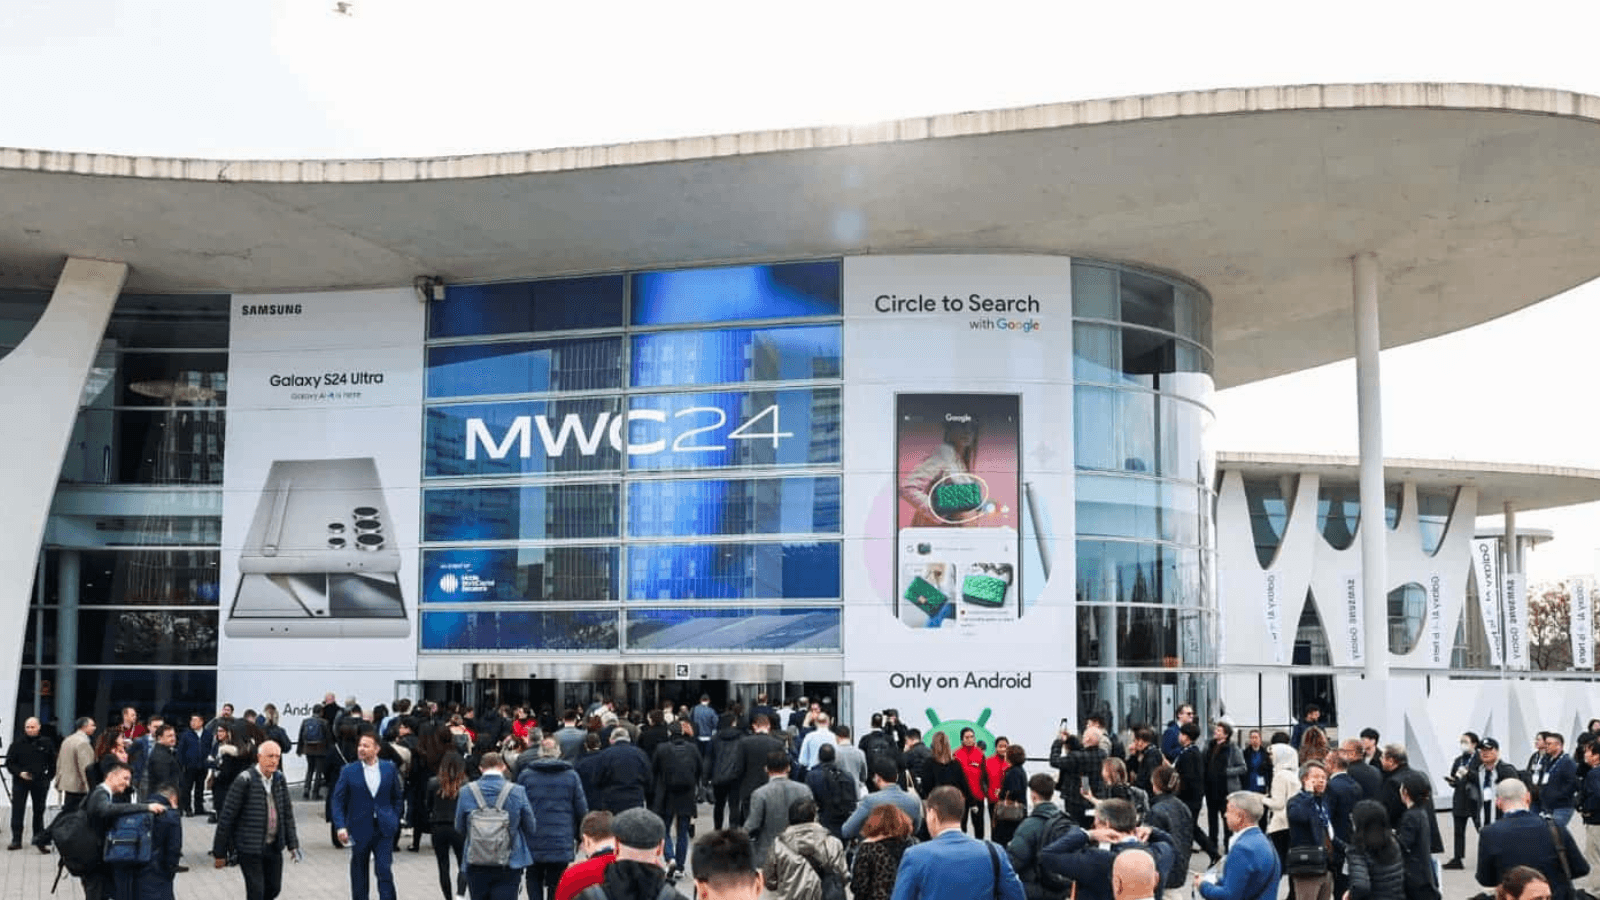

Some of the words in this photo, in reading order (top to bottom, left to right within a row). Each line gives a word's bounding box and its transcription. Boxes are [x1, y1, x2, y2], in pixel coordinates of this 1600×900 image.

[241, 304, 302, 315] SAMSUNG
[875, 294, 936, 313] Circle
[942, 295, 964, 312] to
[969, 294, 1040, 313] Search
[969, 319, 995, 330] with
[996, 318, 1040, 333] Google
[270, 374, 321, 389] Galaxy
[324, 373, 347, 386] S24
[351, 372, 384, 385] Ultra
[465, 404, 794, 460] MWC24
[889, 672, 932, 693] Only
[936, 676, 959, 688] on
[964, 671, 1031, 688] Android
[283, 703, 314, 716] Andr
